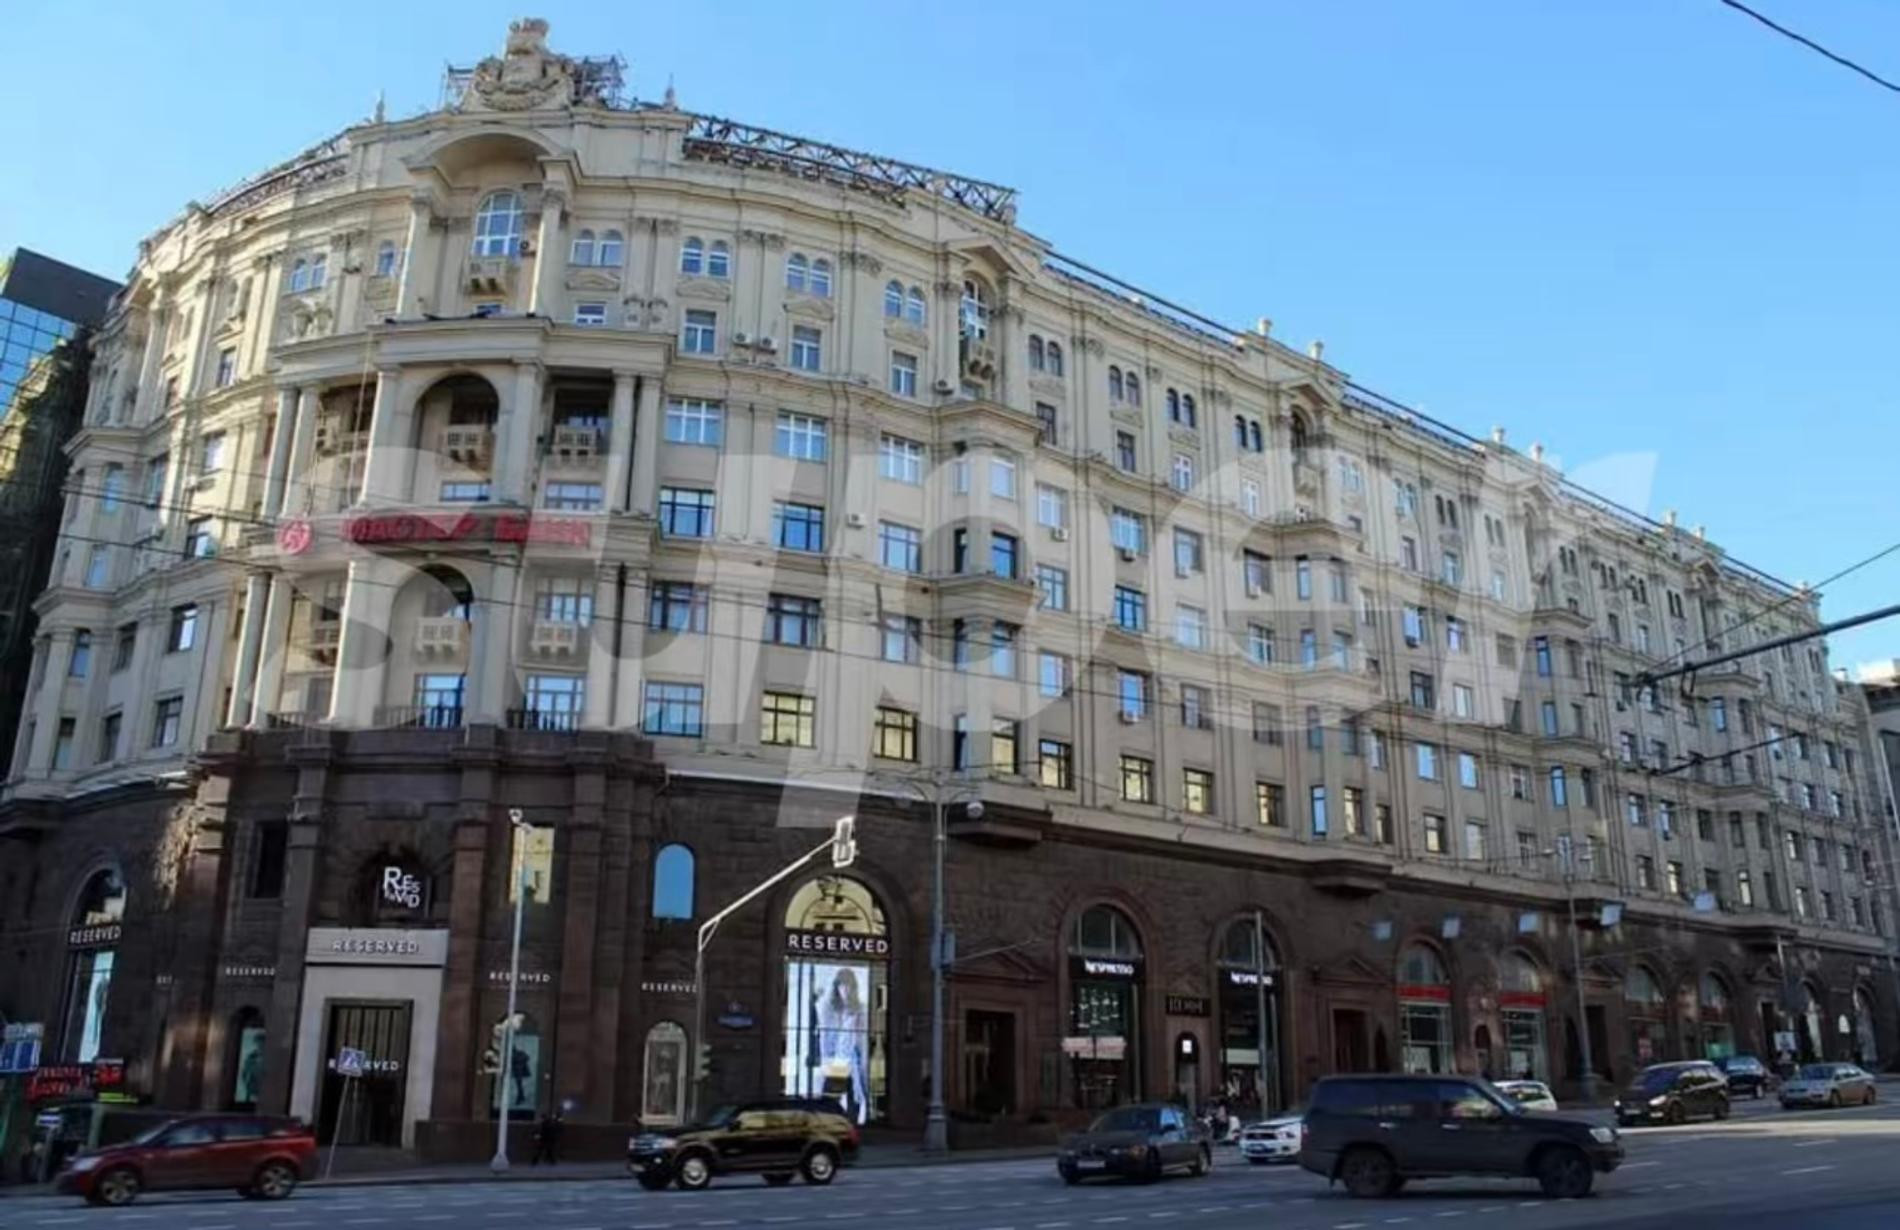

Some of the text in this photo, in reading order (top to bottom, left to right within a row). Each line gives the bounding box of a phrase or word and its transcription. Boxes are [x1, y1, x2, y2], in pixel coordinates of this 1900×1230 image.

[333, 940, 418, 953] RESERVED
[788, 934, 888, 953] RESERVED
[489, 971, 550, 982] RESRVED
[328, 1058, 399, 1072] RRVED
